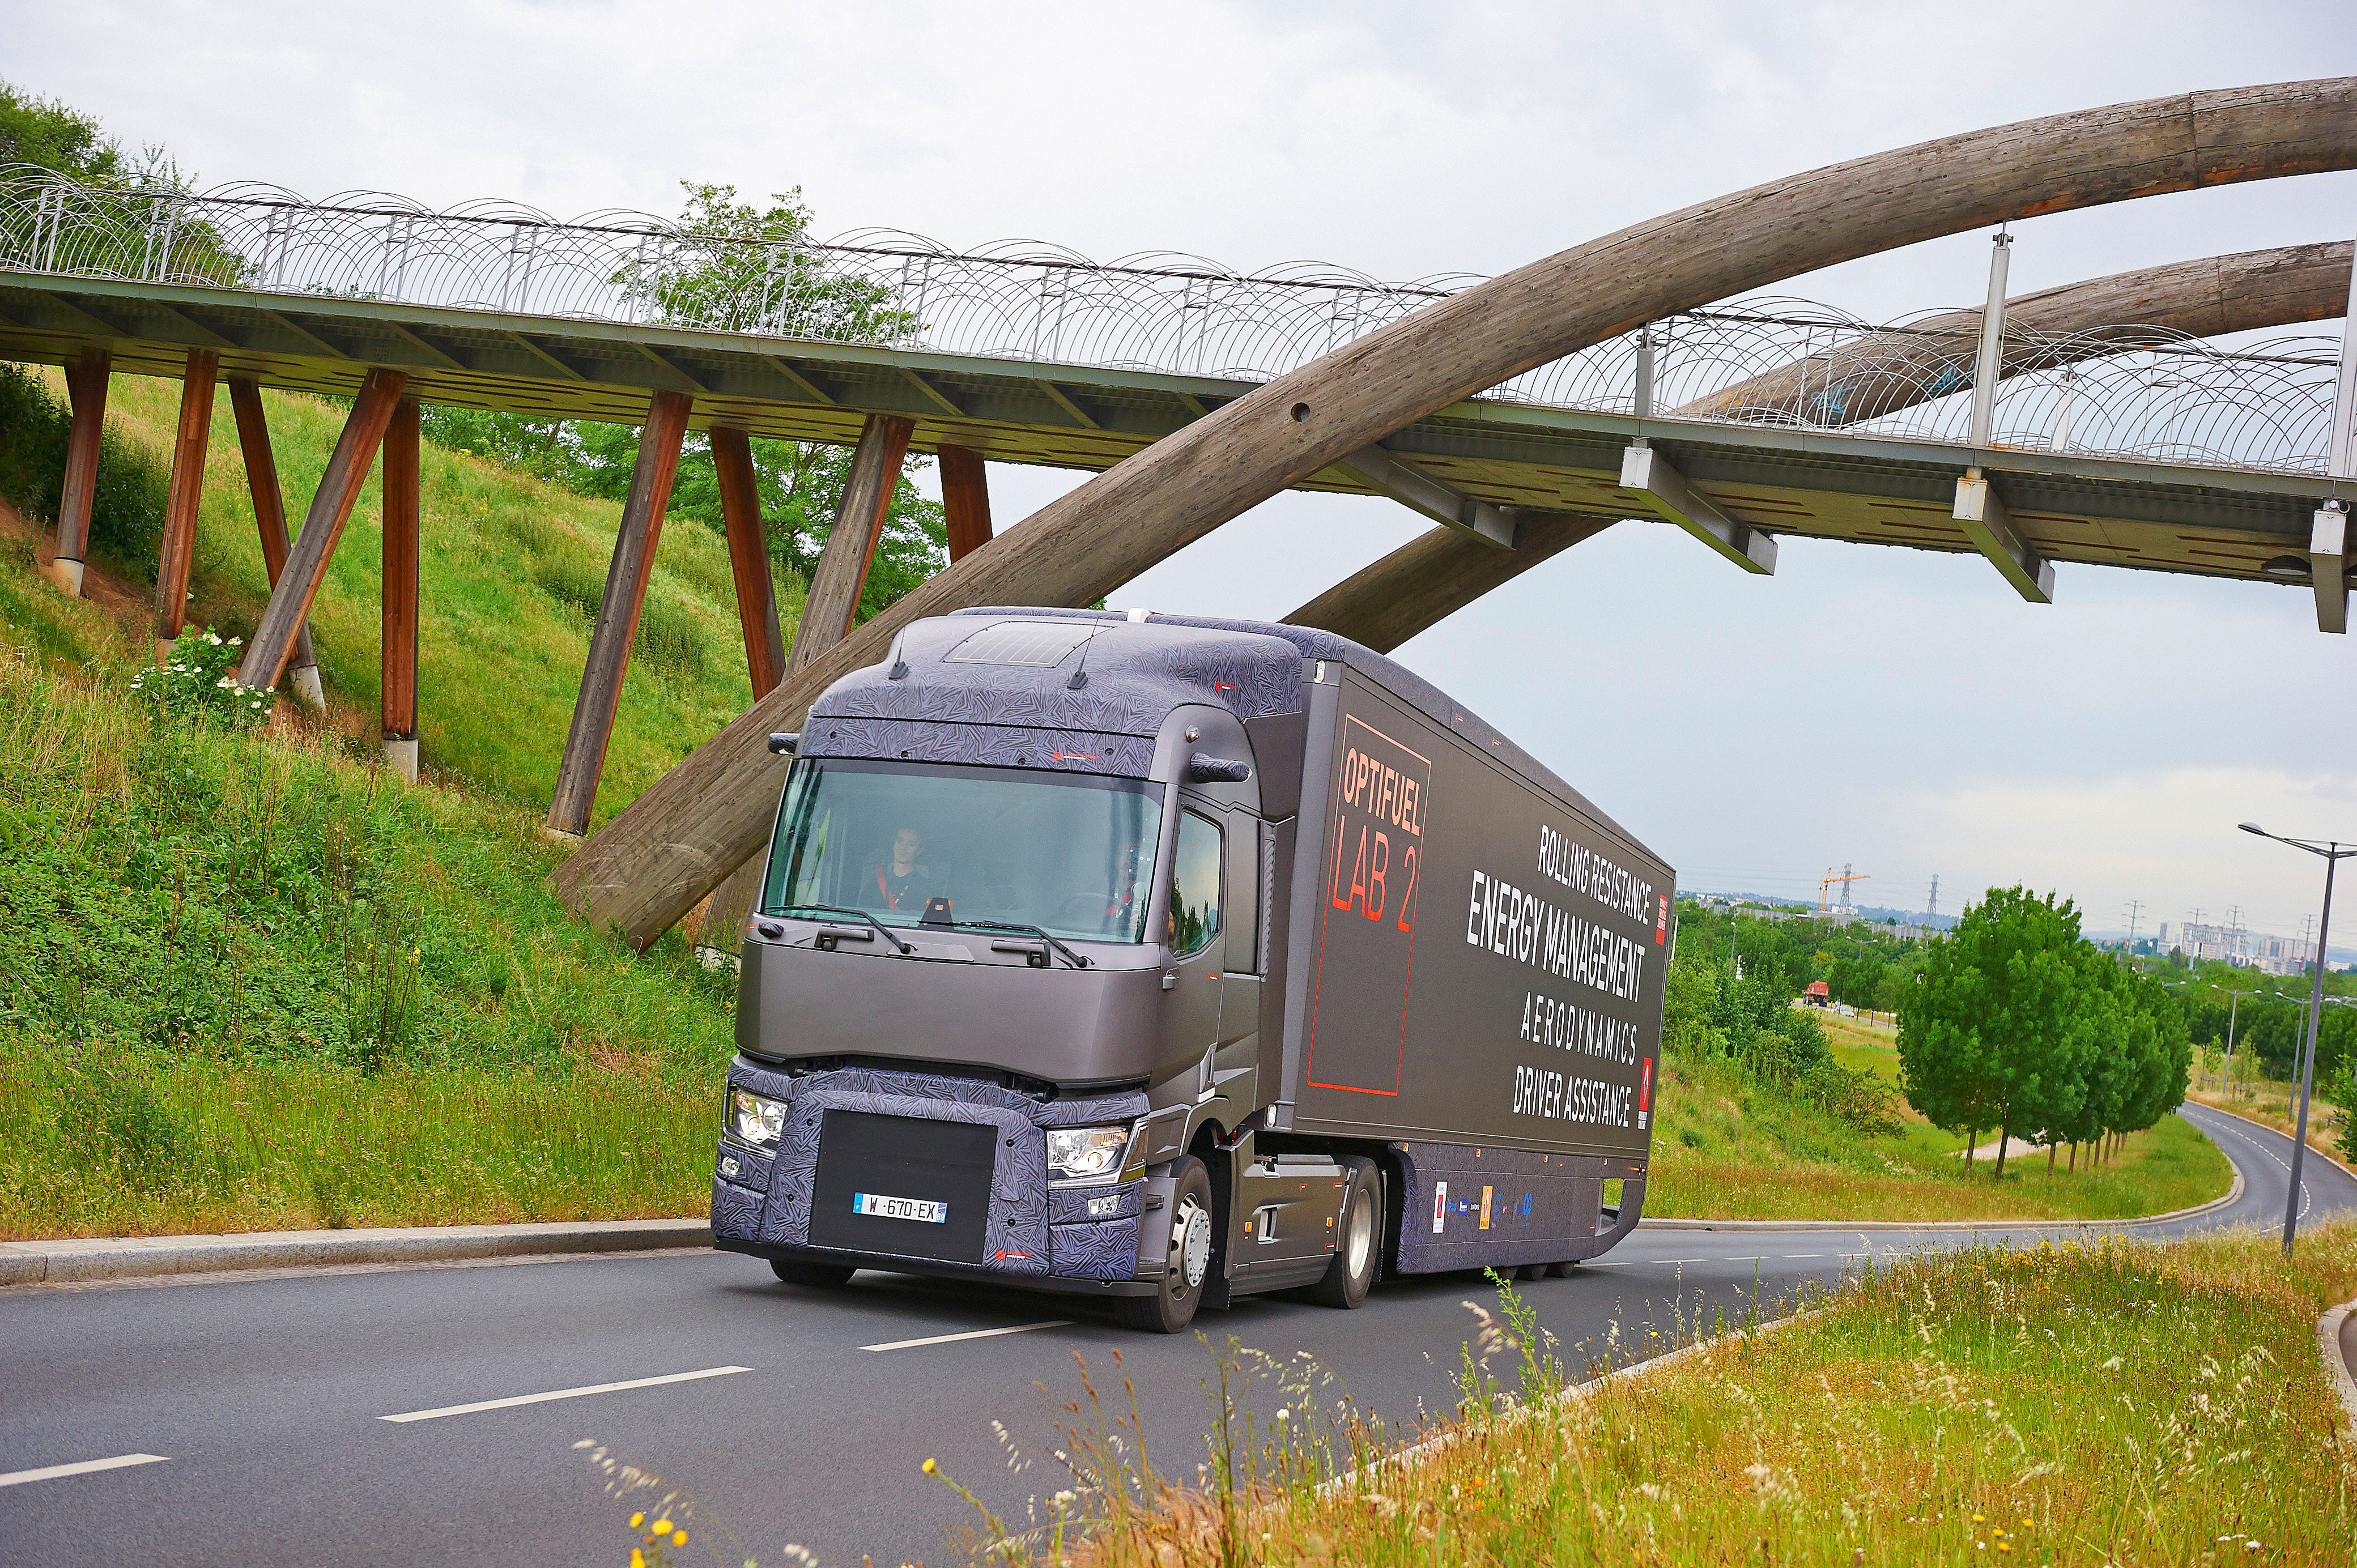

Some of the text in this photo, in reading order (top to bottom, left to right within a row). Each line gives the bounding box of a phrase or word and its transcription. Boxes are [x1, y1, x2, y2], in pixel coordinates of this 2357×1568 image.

[1343, 748, 1420, 837] OPTIFUEL
[1332, 815, 1417, 933] LAB 2
[1537, 824, 1590, 894] ROLLING
[1590, 854, 1652, 926] RESISTANCE
[1466, 870, 1645, 1003] ENERGY MANAGEMENT
[1520, 991, 1637, 1066] AERODYNAMICS
[1513, 1065, 1632, 1127] DRIVER ASSISTANCE
[936, 1213, 946, 1221] 69
